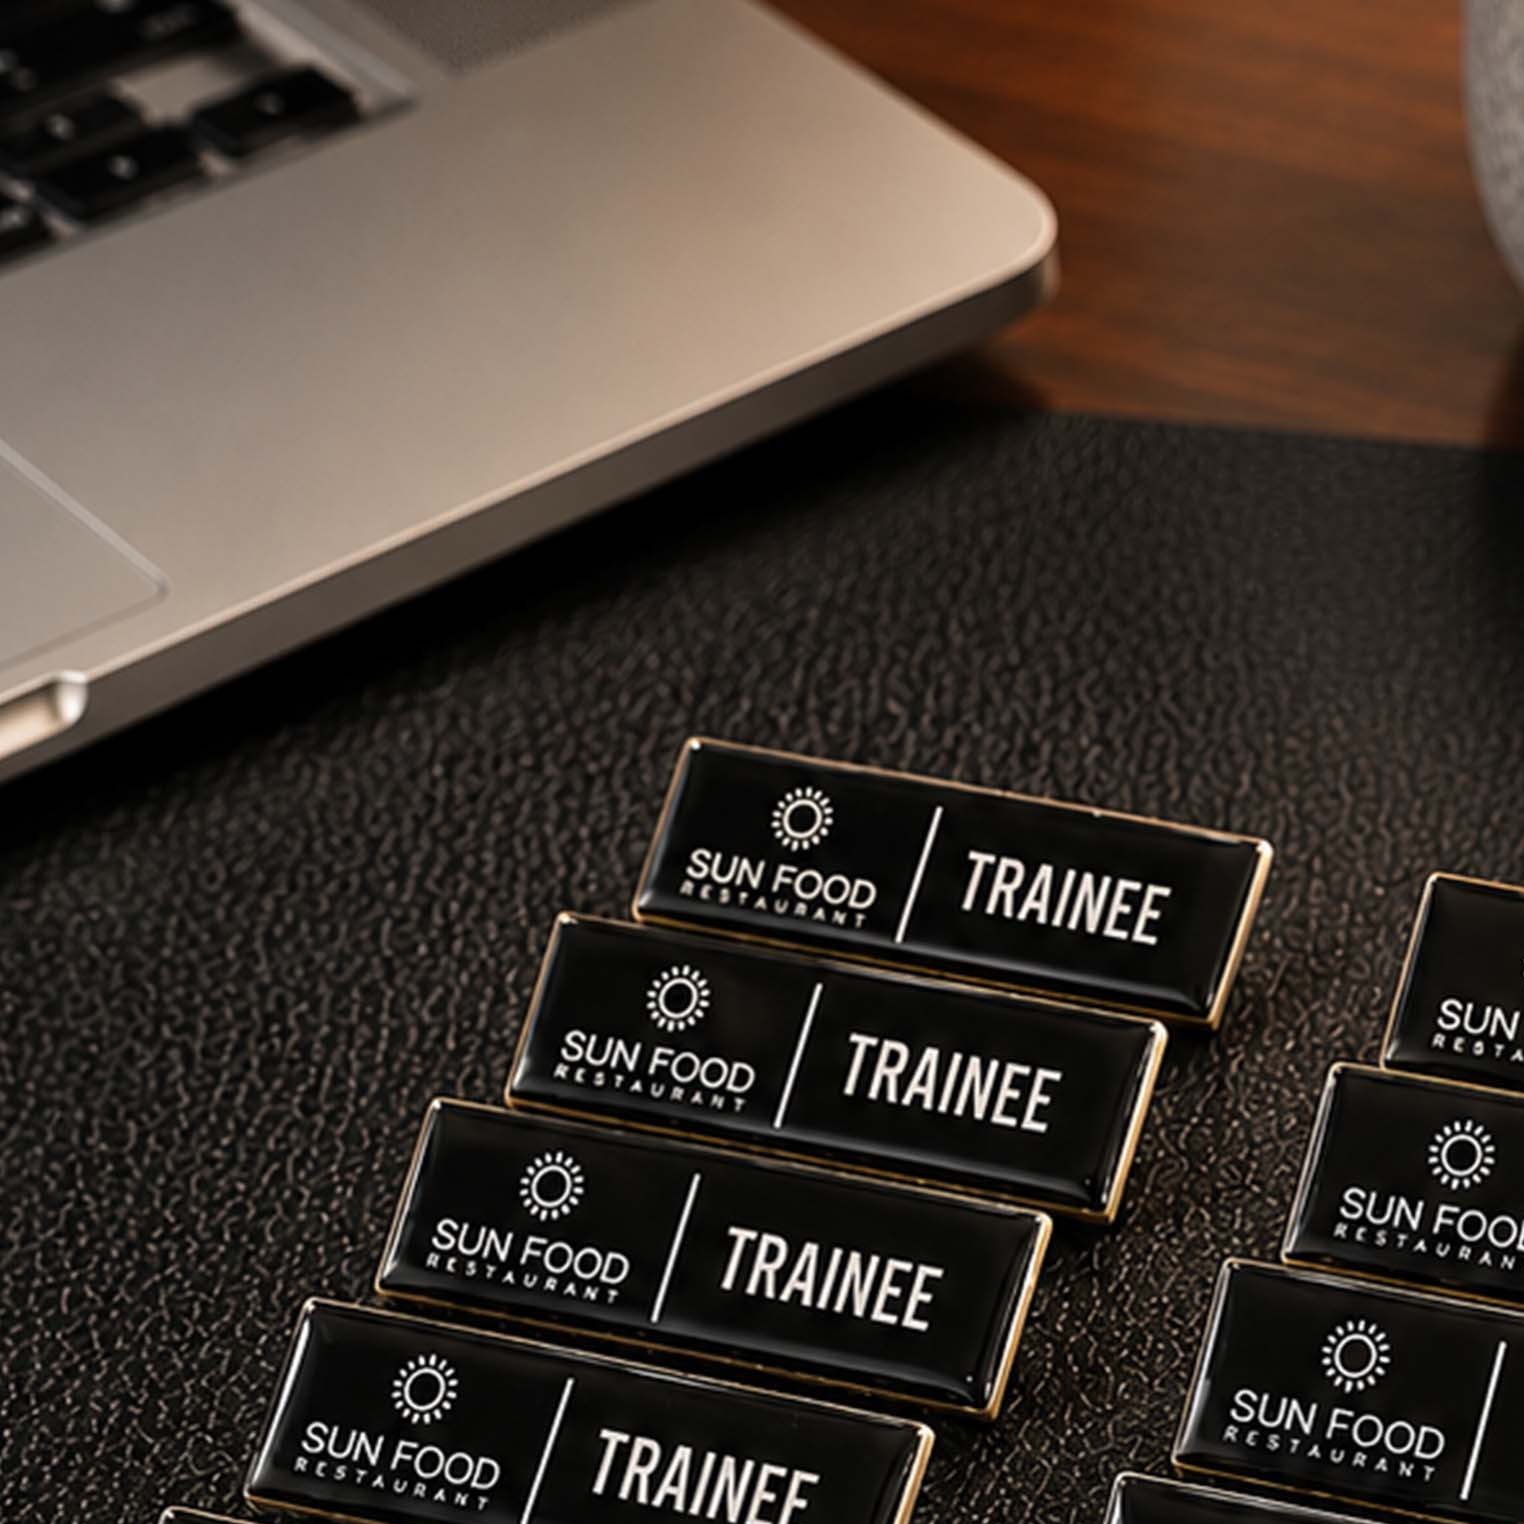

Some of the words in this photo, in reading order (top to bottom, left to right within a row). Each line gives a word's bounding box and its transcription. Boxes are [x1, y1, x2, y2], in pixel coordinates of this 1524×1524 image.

[680, 881, 867, 929] RESTAURANT
[686, 848, 764, 885] SUN
[772, 866, 876, 910] FOOD
[961, 850, 1171, 946] TRAINEE
[1436, 999, 1521, 1040] SUN
[555, 1064, 746, 1112] RESTAURANT
[560, 1030, 641, 1072] SUN
[649, 1048, 755, 1095] FOOD
[843, 1034, 1061, 1133] TRAINEE
[1340, 1187, 1424, 1231] SUN
[427, 1253, 619, 1303] RESTAURANT
[432, 1219, 513, 1262] SUN
[520, 1236, 629, 1284] FOOD
[720, 1227, 943, 1332] TRAINEE
[1224, 1427, 1436, 1482] RESTAURANT
[1229, 1389, 1318, 1435] SUN
[1325, 1406, 1444, 1460] FOOD
[294, 1457, 488, 1511] RESTAURANT
[301, 1422, 384, 1466] SUN
[390, 1440, 500, 1490] FOOD
